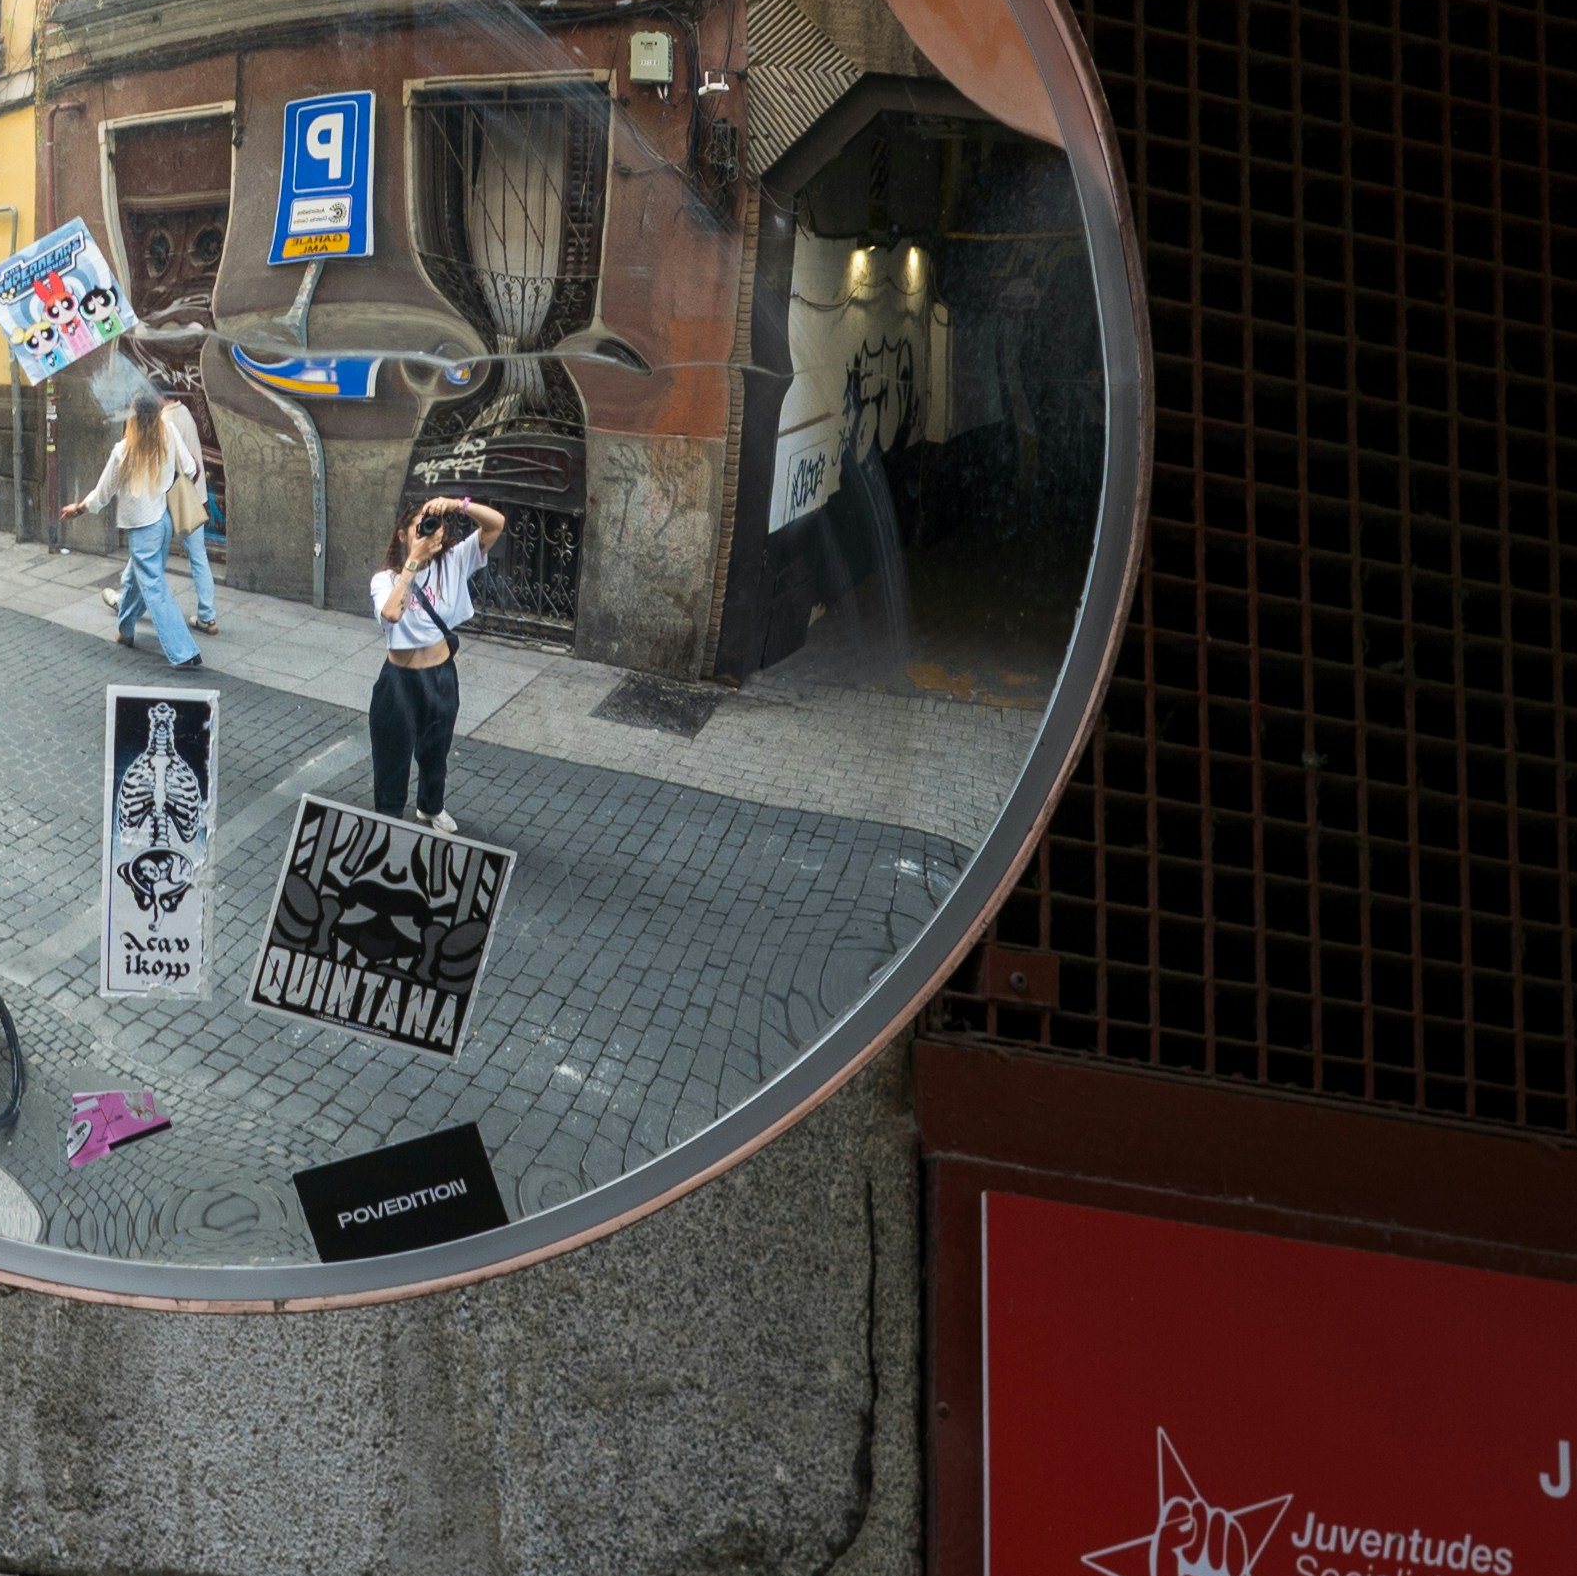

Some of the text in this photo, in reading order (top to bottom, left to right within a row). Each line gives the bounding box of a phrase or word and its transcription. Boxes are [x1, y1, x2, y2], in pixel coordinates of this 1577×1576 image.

[259, 945, 459, 1047] QUINTANA
[337, 1178, 468, 1229] POVEDITION
[1291, 1511, 1514, 1576] Juventudes
